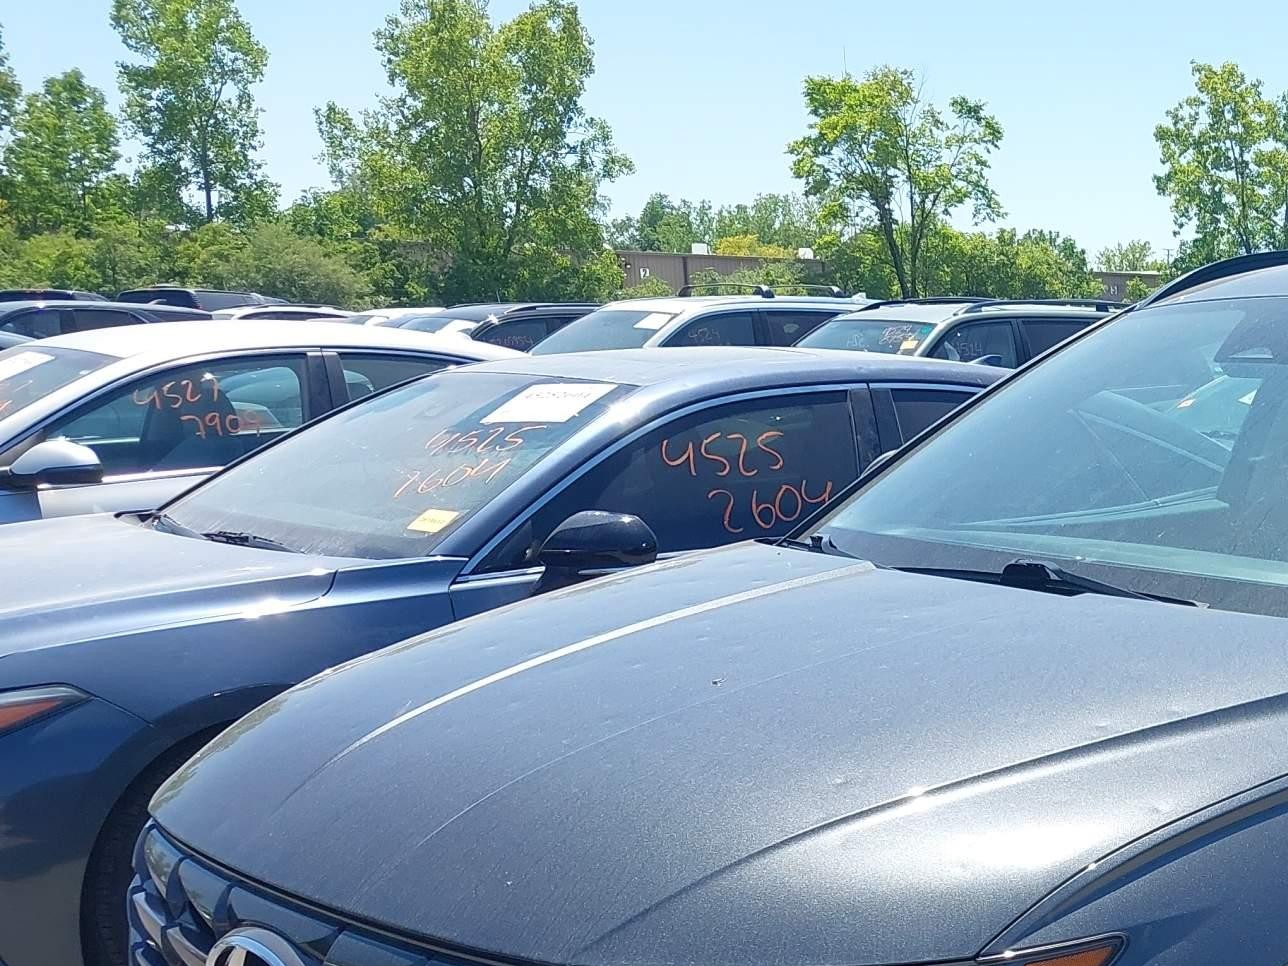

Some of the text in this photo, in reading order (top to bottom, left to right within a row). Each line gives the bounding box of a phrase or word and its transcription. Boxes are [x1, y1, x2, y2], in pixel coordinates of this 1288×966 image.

[425, 425, 548, 457] 4525
[661, 431, 785, 477] 4525
[707, 480, 833, 534] 2604
